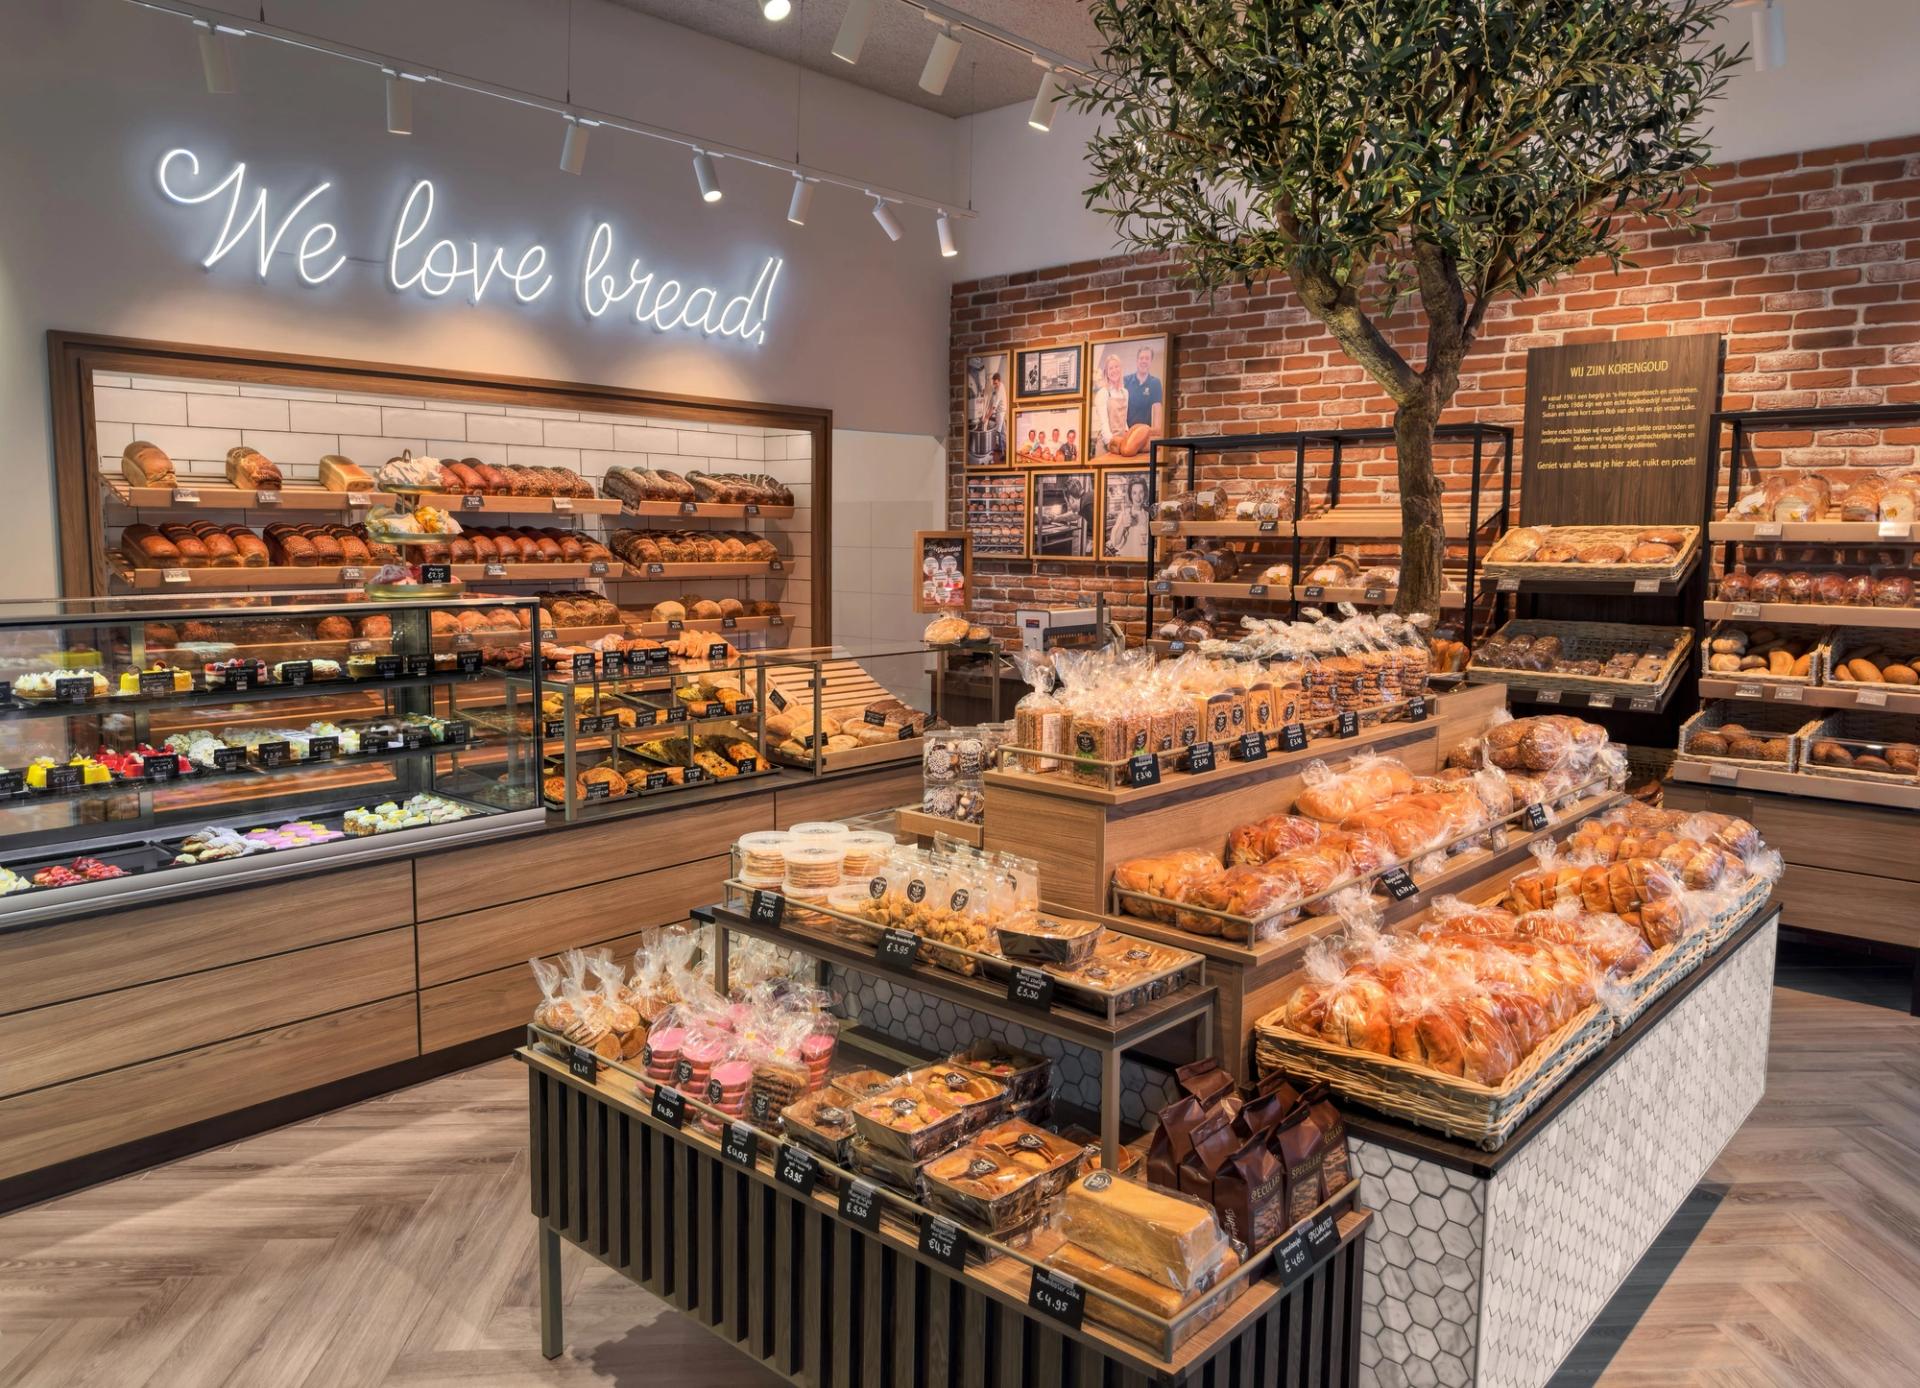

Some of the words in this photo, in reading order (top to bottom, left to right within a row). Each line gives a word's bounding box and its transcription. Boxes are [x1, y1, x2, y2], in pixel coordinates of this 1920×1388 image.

[159, 148, 347, 284] We
[389, 180, 553, 304] love
[584, 222, 784, 345] bread!
[1570, 366, 1583, 377] WIJ
[1586, 365, 1605, 377] ZIJN
[1608, 360, 1669, 375] KORENGOUD
[1612, 426, 1625, 434] jullie
[1673, 432, 1687, 440] wijze
[1537, 461, 1558, 470] Geniet
[1573, 460, 1589, 469] alles
[1603, 460, 1610, 470] je
[1612, 459, 1624, 467] hier
[1626, 458, 1641, 467] ziet,
[1643, 458, 1660, 466] ruikt
[1671, 457, 1697, 468] proeft!
